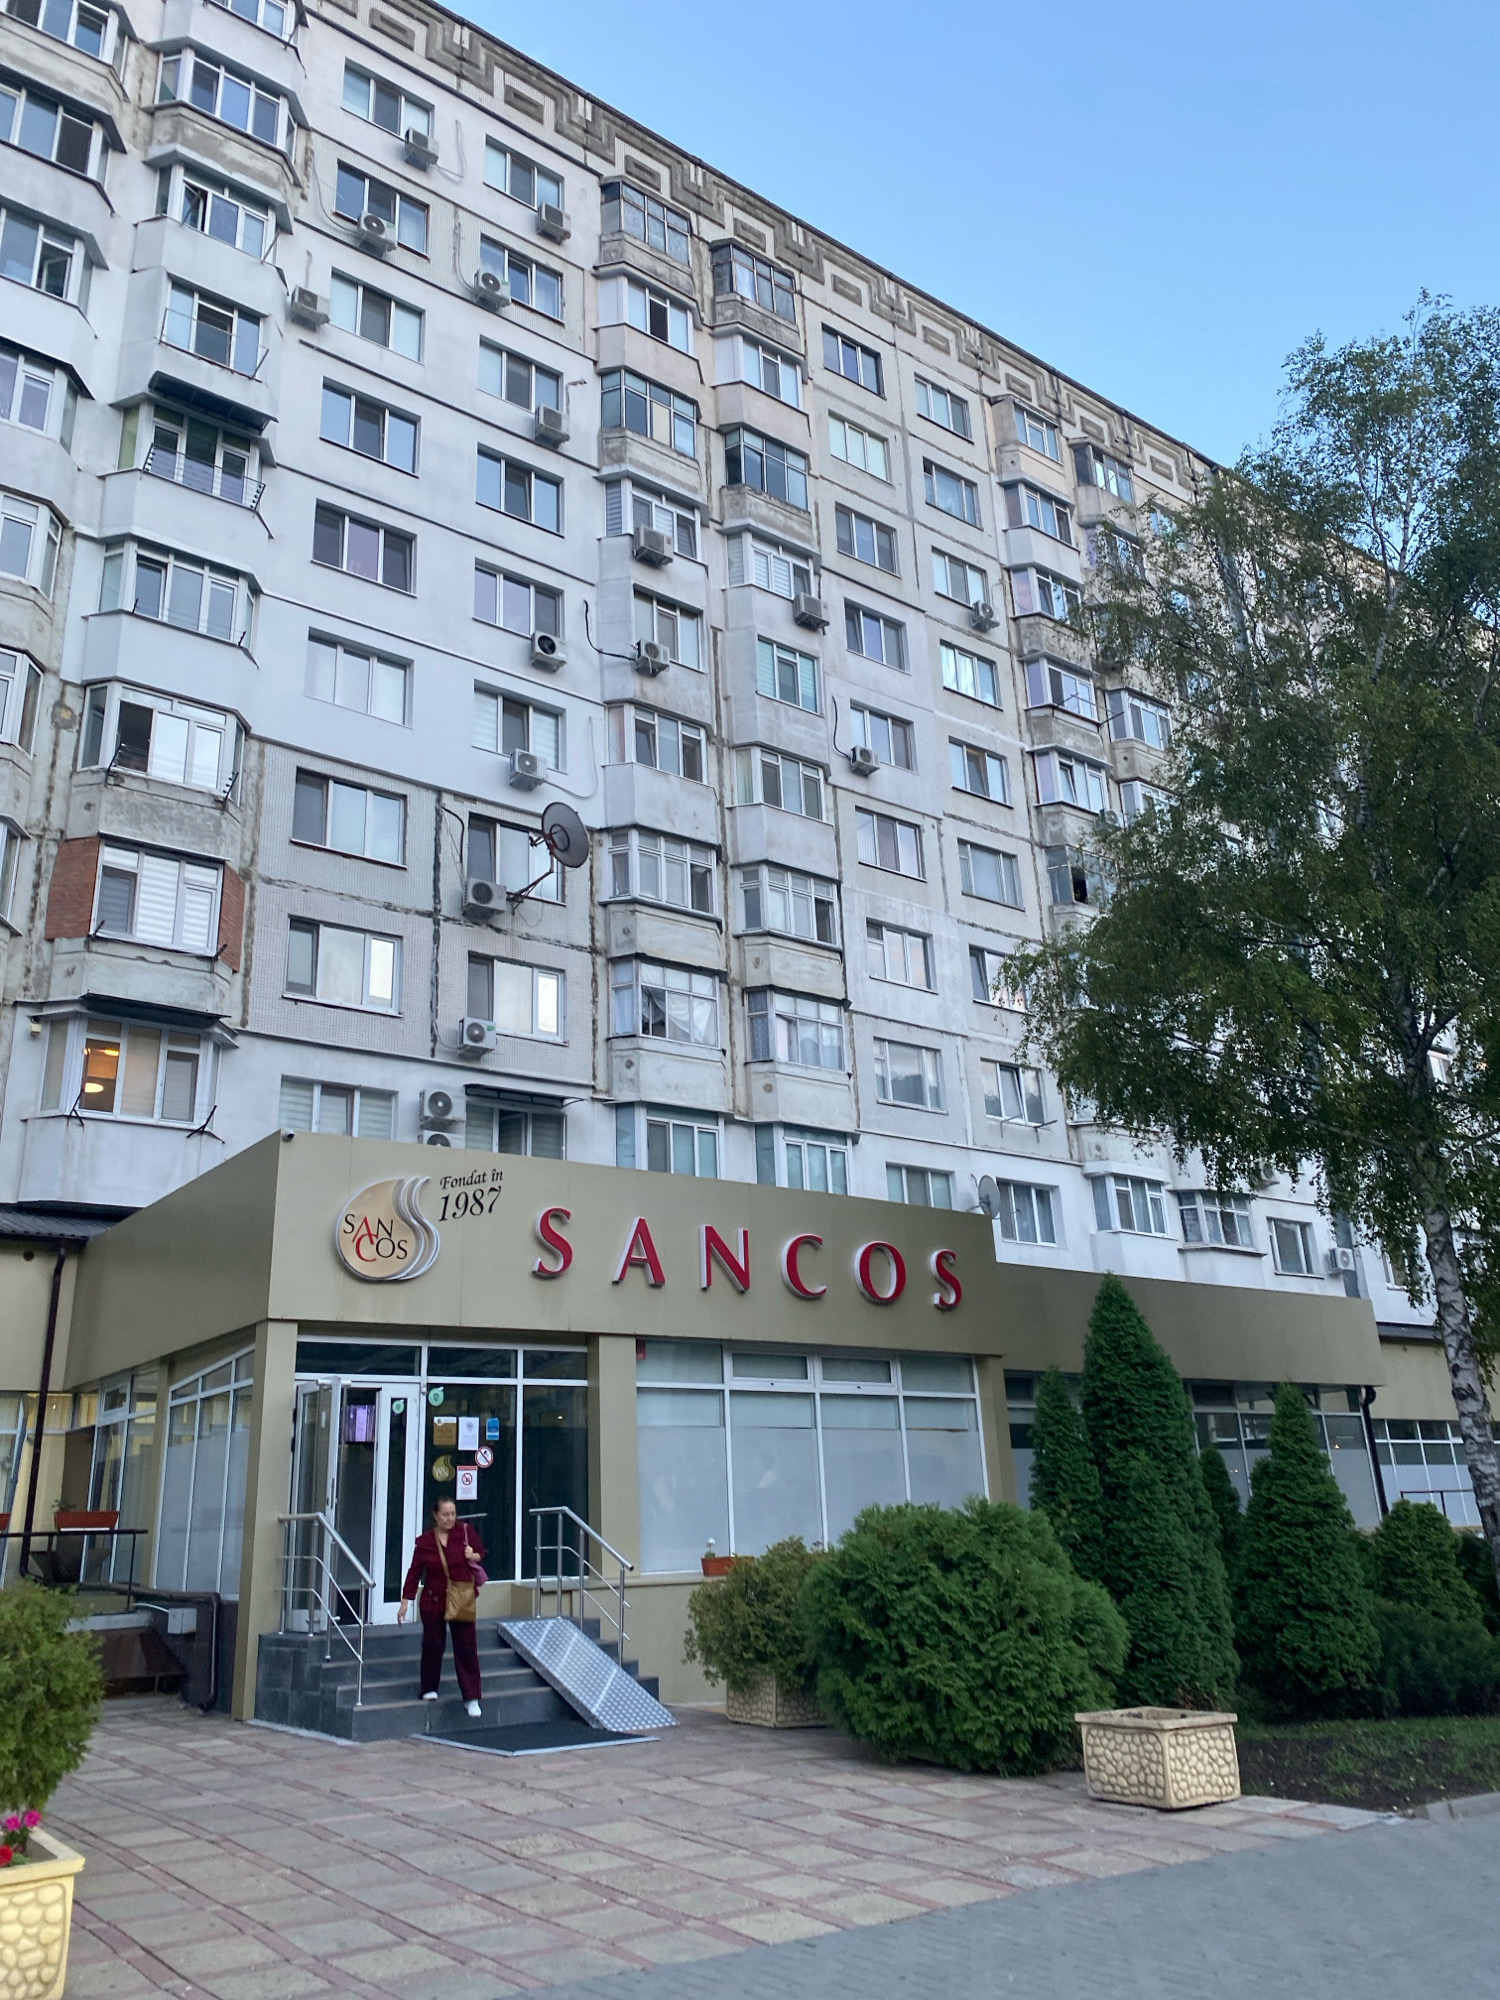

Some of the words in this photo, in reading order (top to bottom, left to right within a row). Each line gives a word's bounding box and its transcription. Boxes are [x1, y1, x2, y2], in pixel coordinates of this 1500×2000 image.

[440, 1169, 487, 1189] Fondat
[491, 1168, 503, 1182] în
[438, 1186, 501, 1221] 1987
[343, 1213, 393, 1245] SAN
[355, 1233, 408, 1262] COS
[531, 1206, 962, 1310] SANCOS
